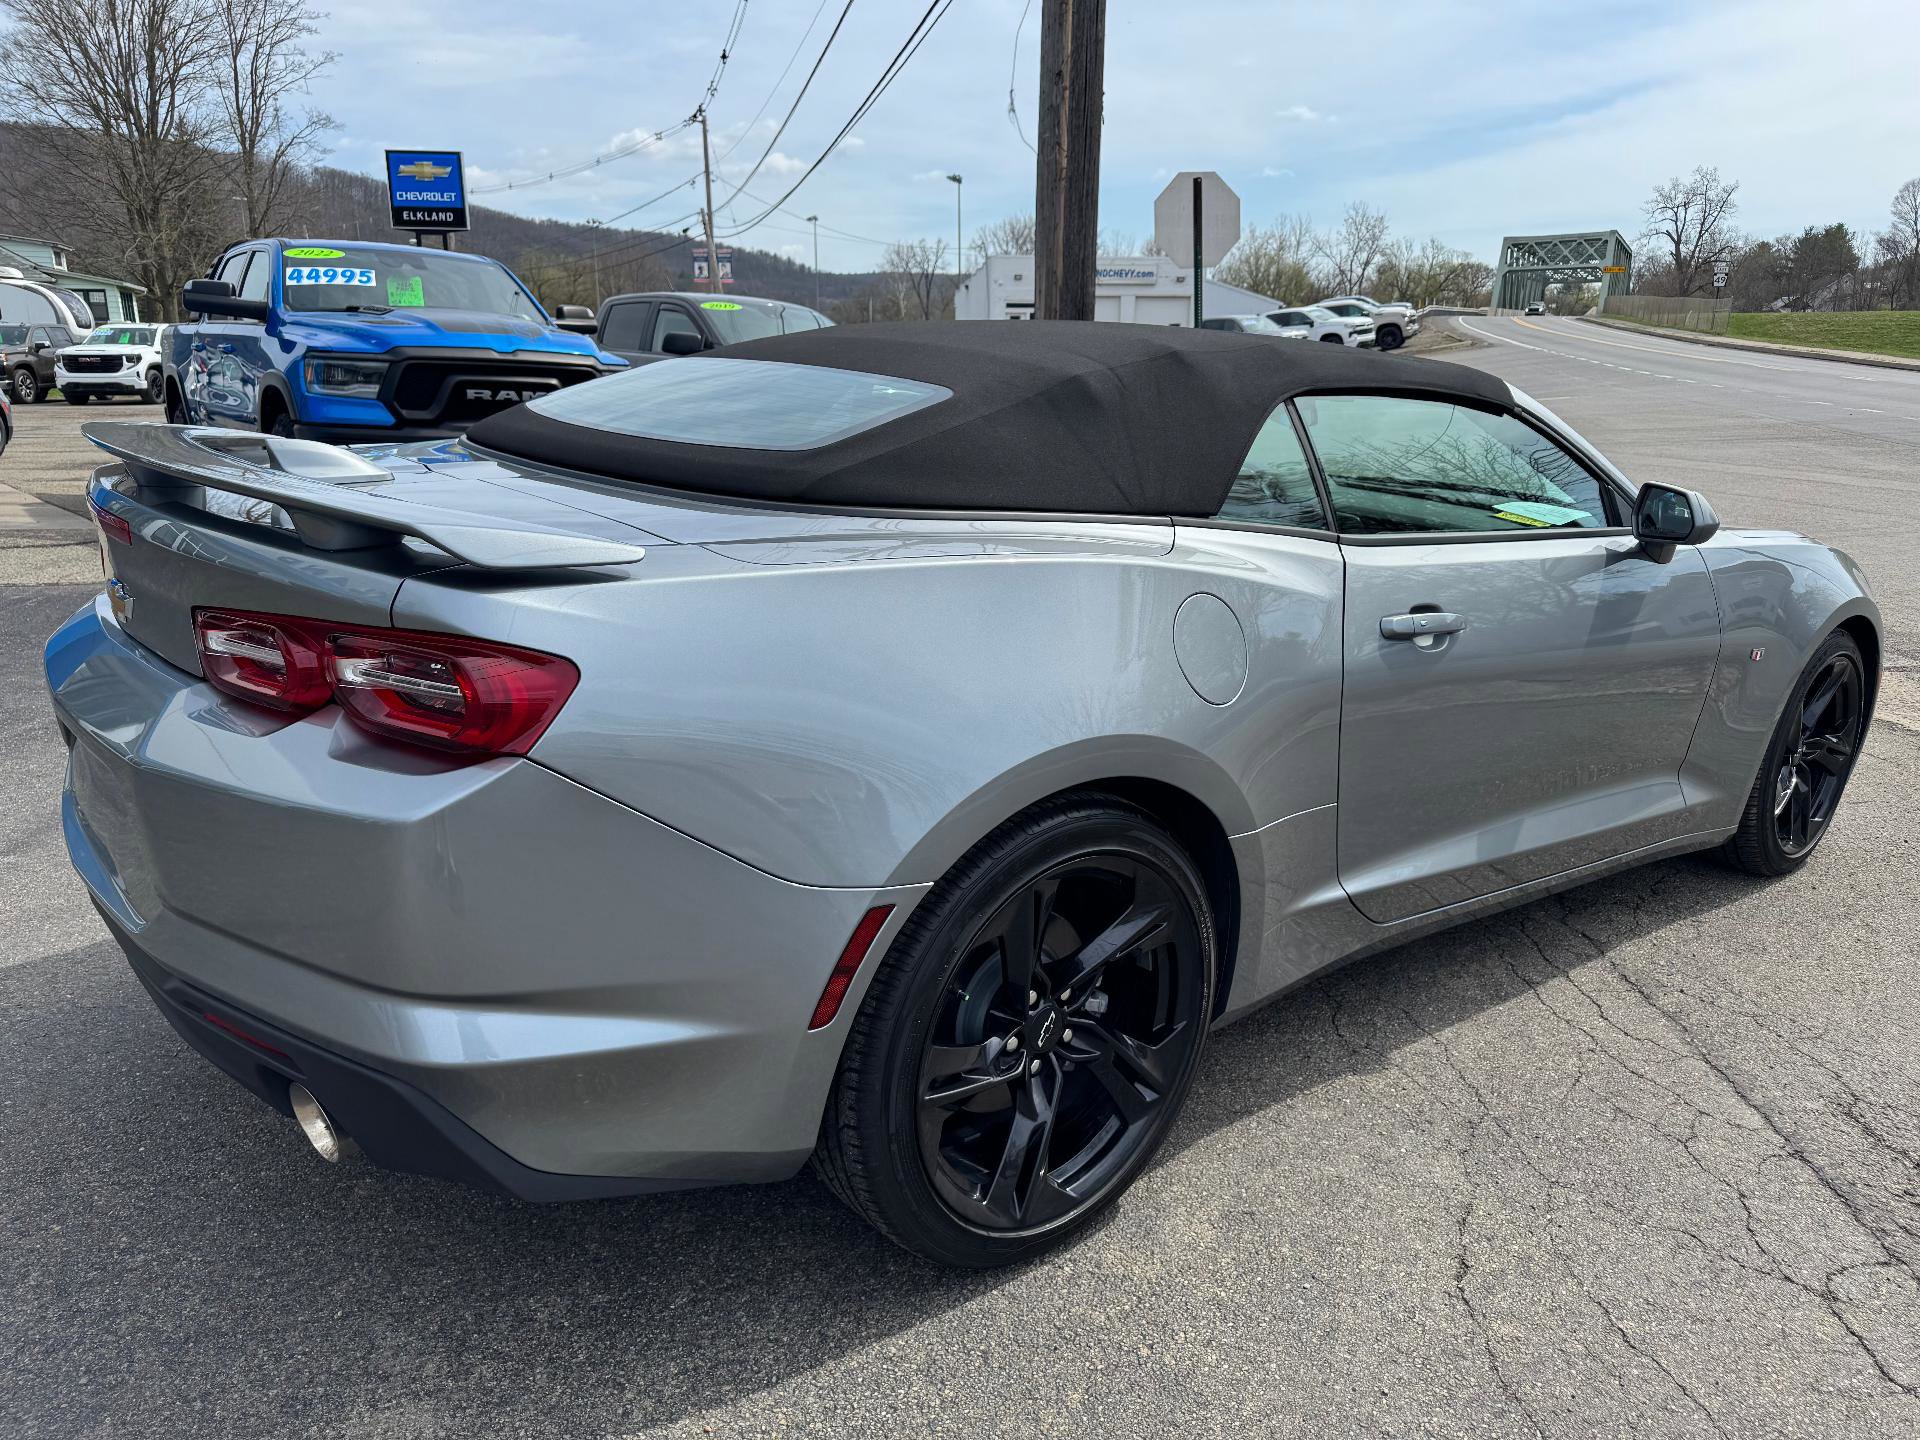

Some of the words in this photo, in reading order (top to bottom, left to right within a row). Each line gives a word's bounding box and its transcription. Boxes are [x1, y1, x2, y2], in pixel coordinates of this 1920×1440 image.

[396, 191, 457, 202] CHEVROLET
[402, 210, 454, 222] ELKLAND
[293, 249, 335, 257] 2022
[287, 268, 373, 284] 44995
[1714, 276, 1727, 284] 49
